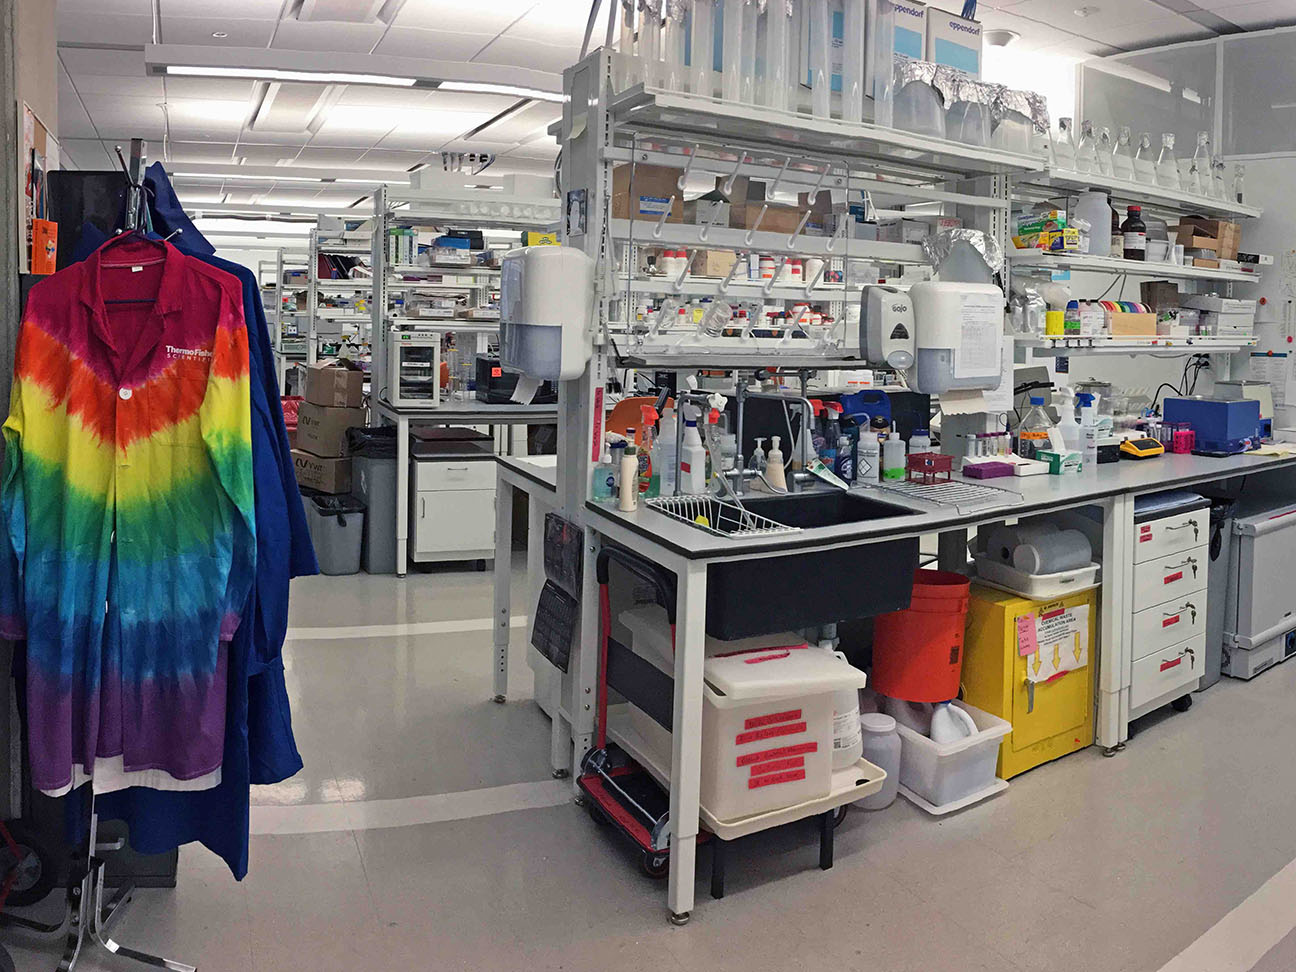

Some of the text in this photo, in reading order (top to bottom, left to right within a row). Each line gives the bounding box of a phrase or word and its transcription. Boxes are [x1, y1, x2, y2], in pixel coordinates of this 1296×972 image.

[895, 4, 924, 18] ppendorf
[949, 20, 980, 36] eppendorf
[165, 344, 212, 357] ThermoFishe
[166, 353, 210, 362] SCIENTIFI
